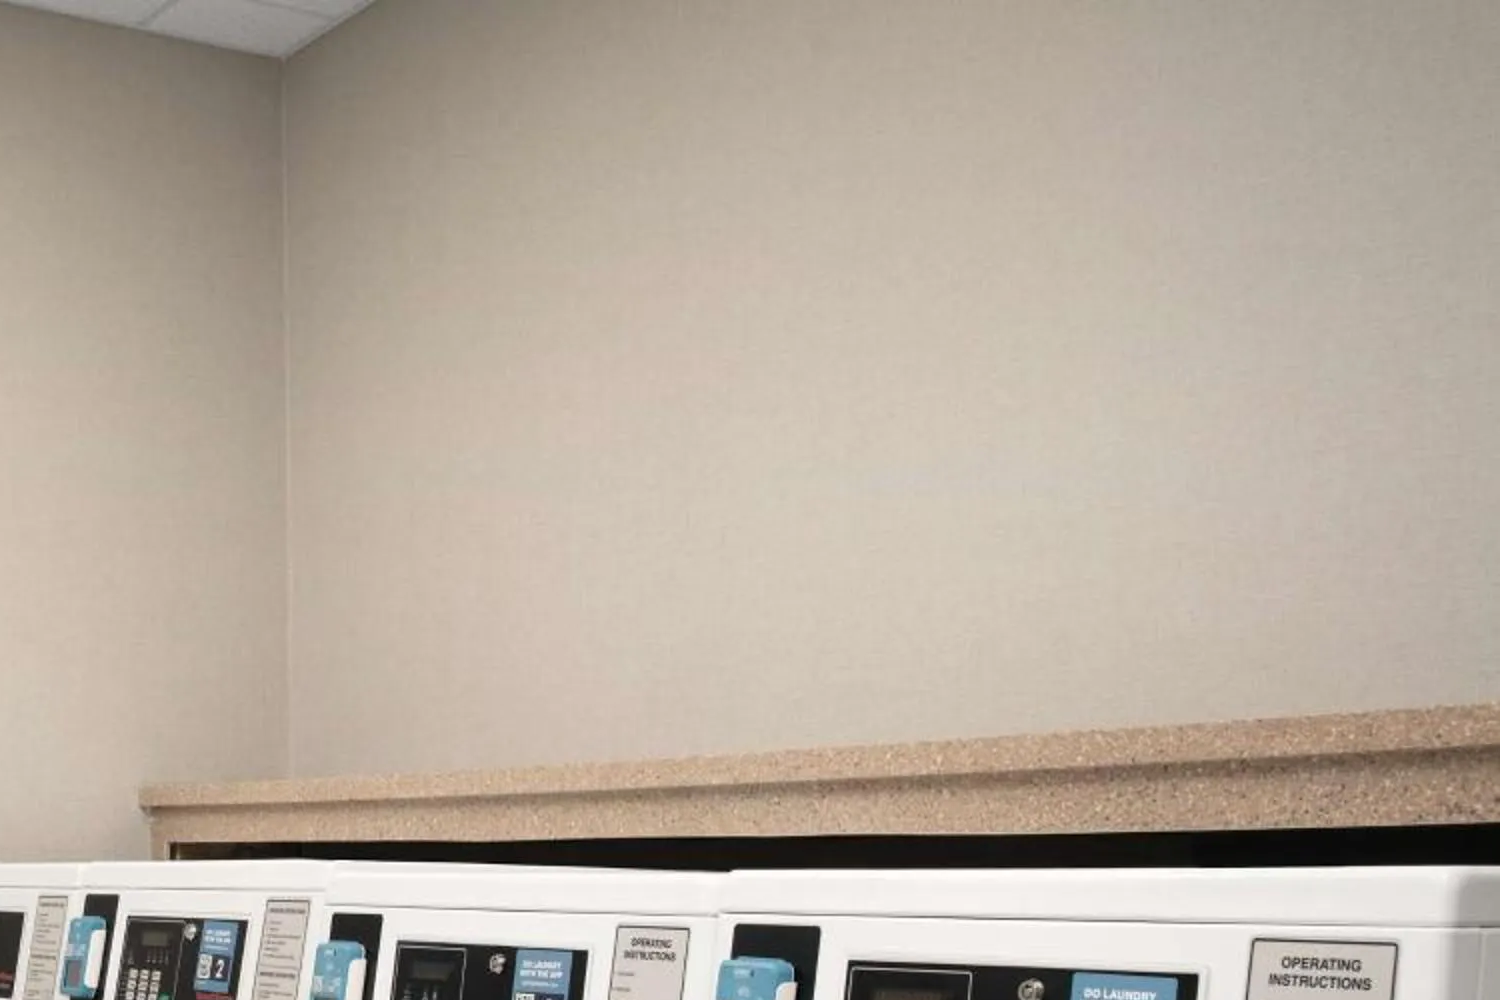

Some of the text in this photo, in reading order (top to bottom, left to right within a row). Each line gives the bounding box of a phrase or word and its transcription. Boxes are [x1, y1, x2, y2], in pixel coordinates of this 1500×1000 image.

[215, 959, 225, 979] 2
[1280, 956, 1363, 972] OPERATING
[1268, 973, 1373, 991] INSTRUCTIONS
